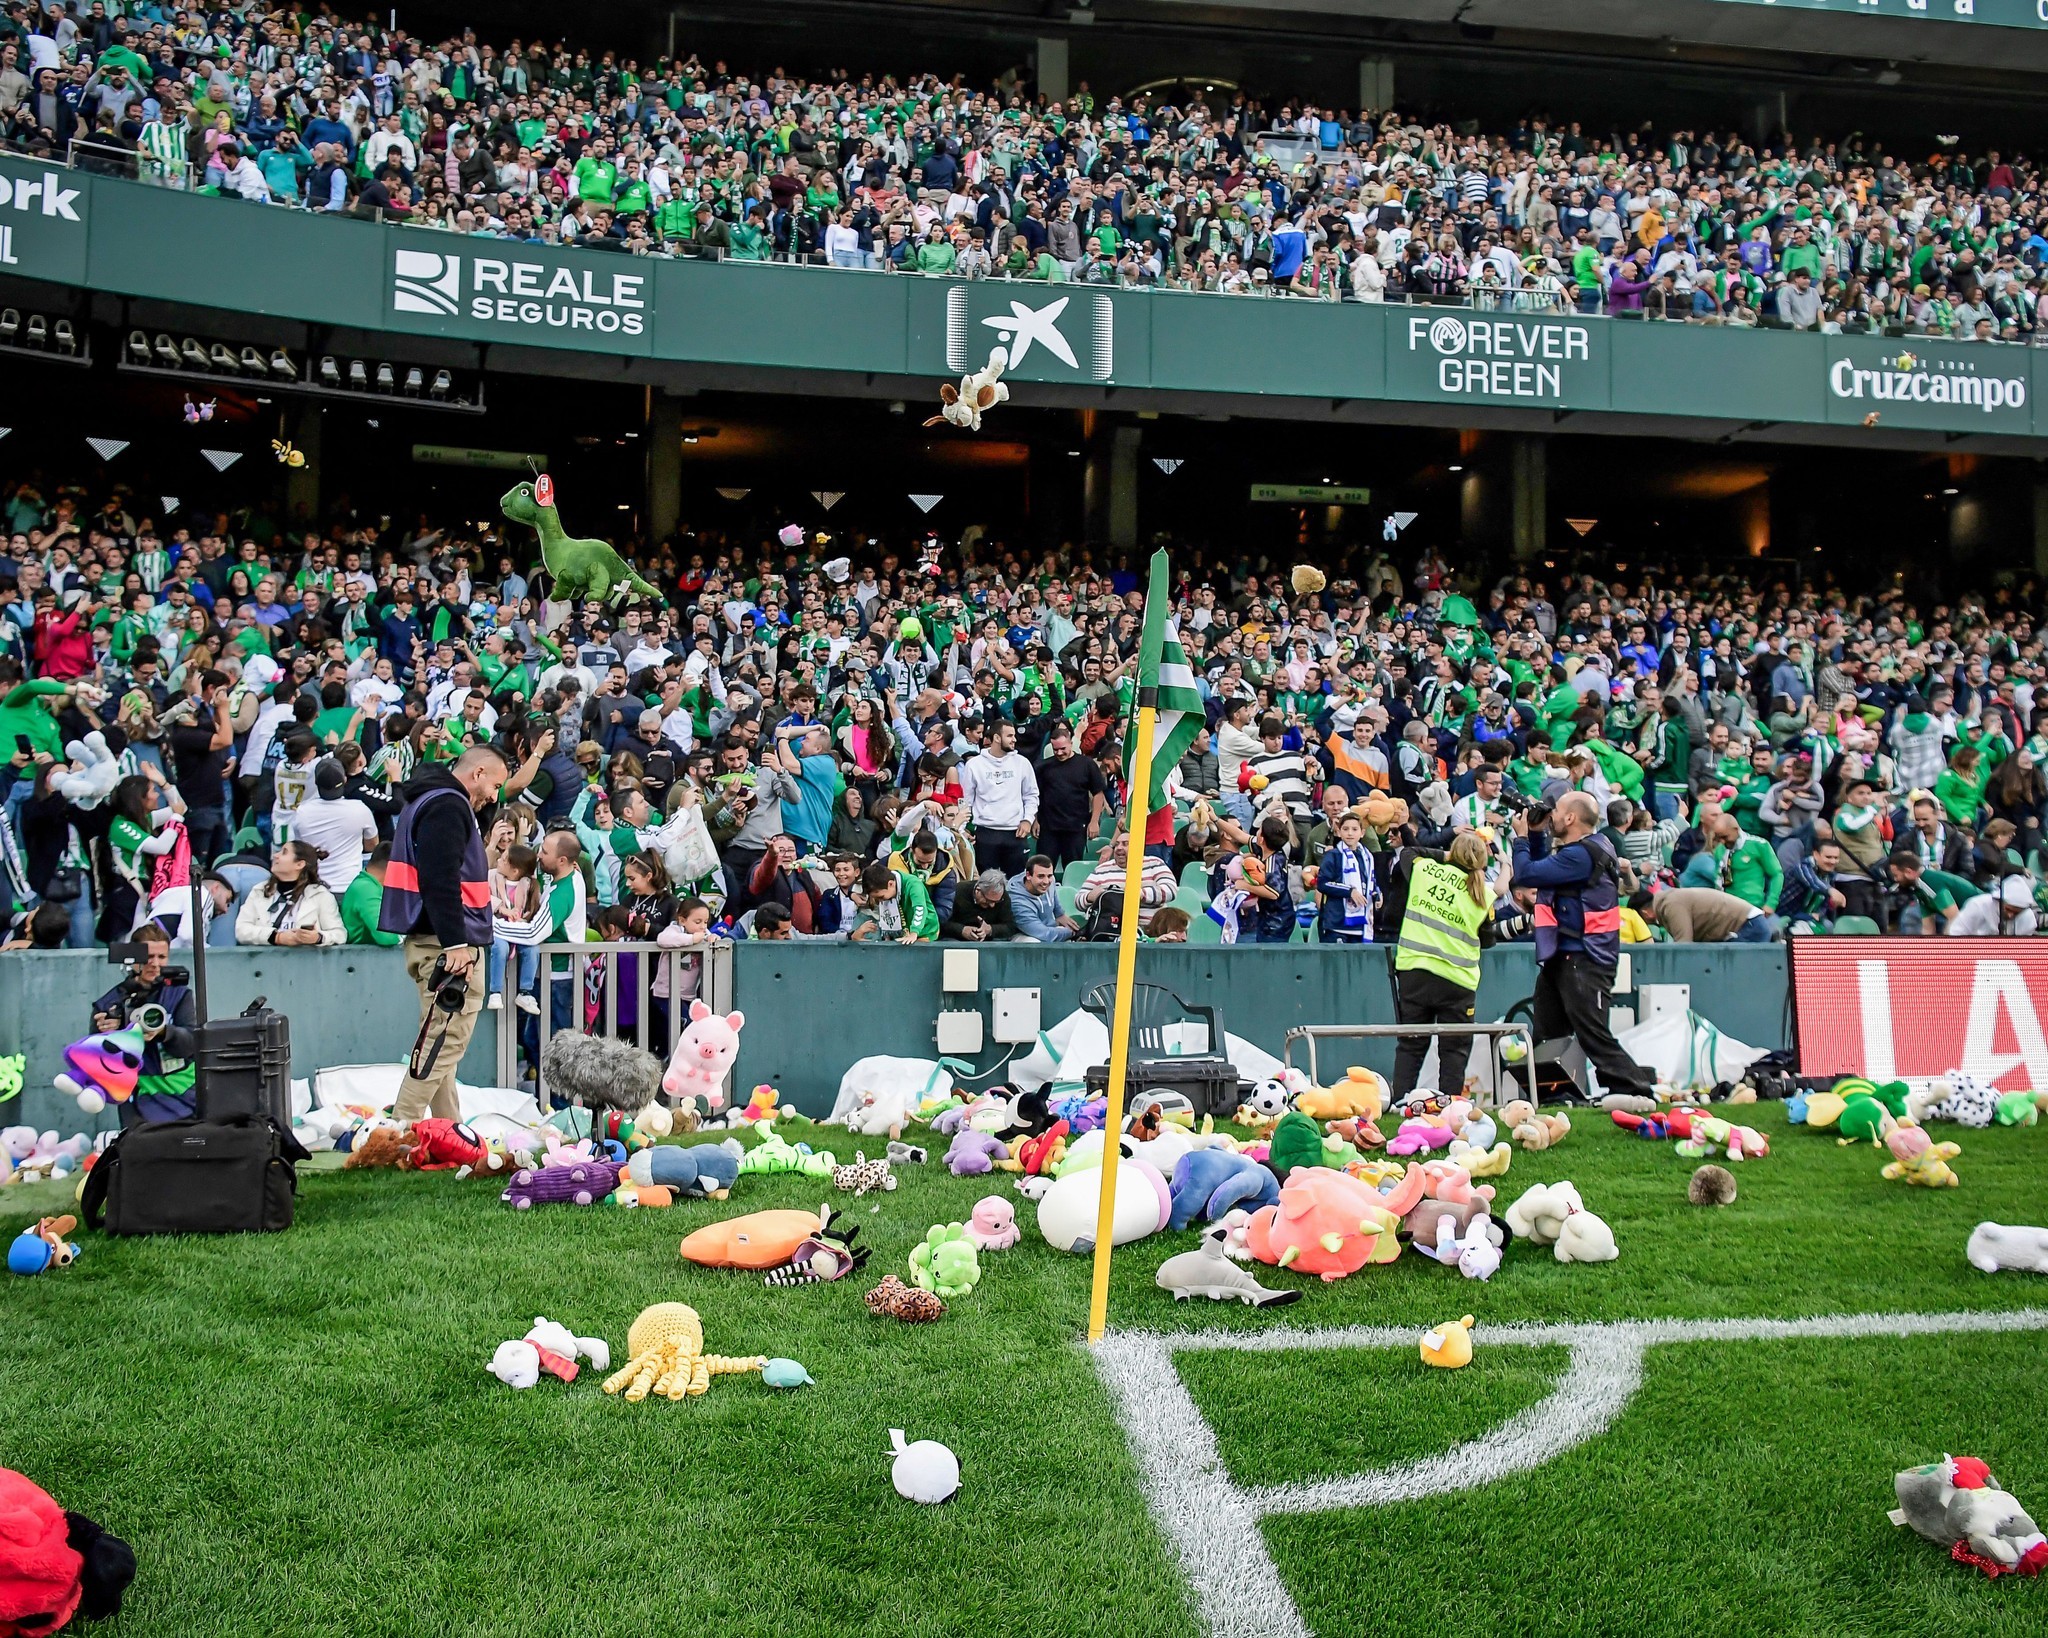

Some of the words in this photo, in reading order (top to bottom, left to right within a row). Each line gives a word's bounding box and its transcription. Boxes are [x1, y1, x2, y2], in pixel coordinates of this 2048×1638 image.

[473, 258, 645, 308] REALE
[470, 297, 645, 335] SEGUROS
[1409, 317, 1589, 360] FOREVER
[1439, 358, 1561, 397] GREEN
[1829, 357, 2026, 412] Cruzcampo
[1427, 885, 1455, 906] 434
[1856, 960, 2048, 1098] LA
